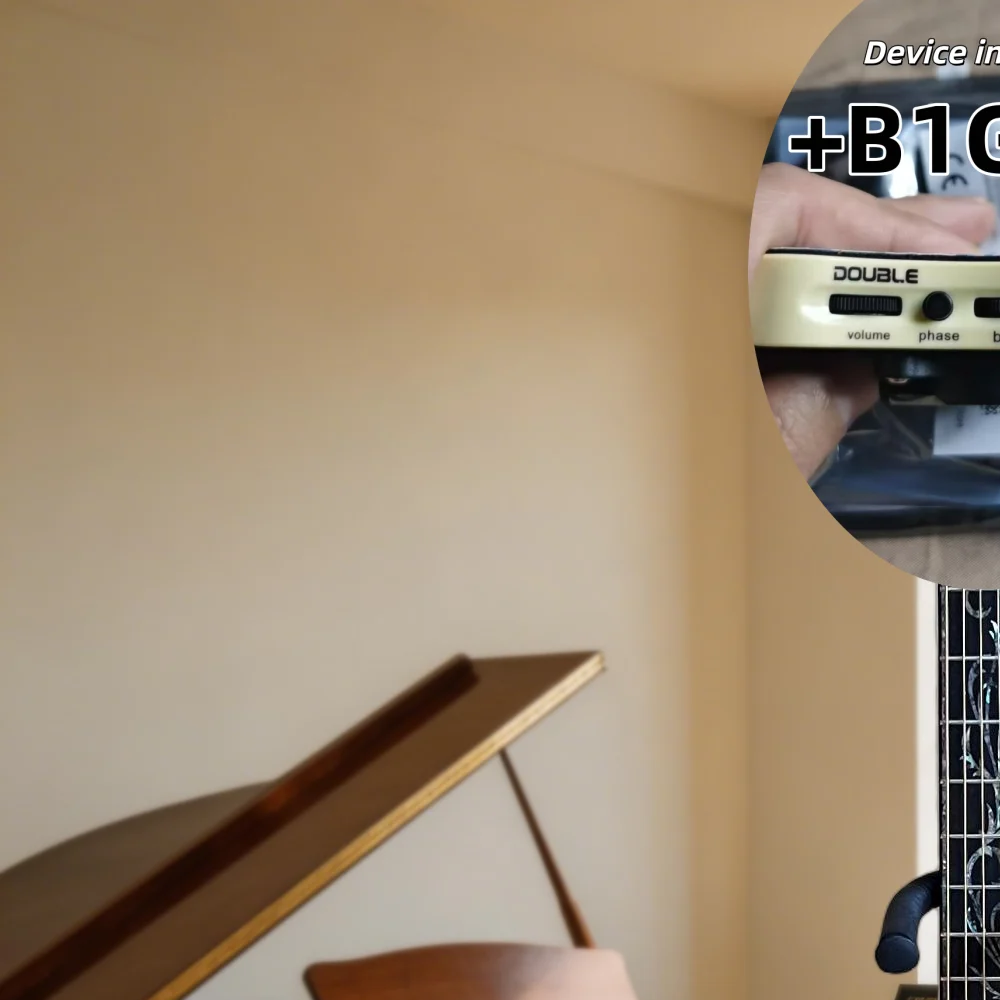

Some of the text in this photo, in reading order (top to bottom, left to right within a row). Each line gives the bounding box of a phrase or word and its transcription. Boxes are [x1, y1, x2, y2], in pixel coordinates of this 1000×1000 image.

[833, 265, 919, 284] DOUBLE
[847, 329, 891, 341] volume
[918, 330, 960, 343] phase
